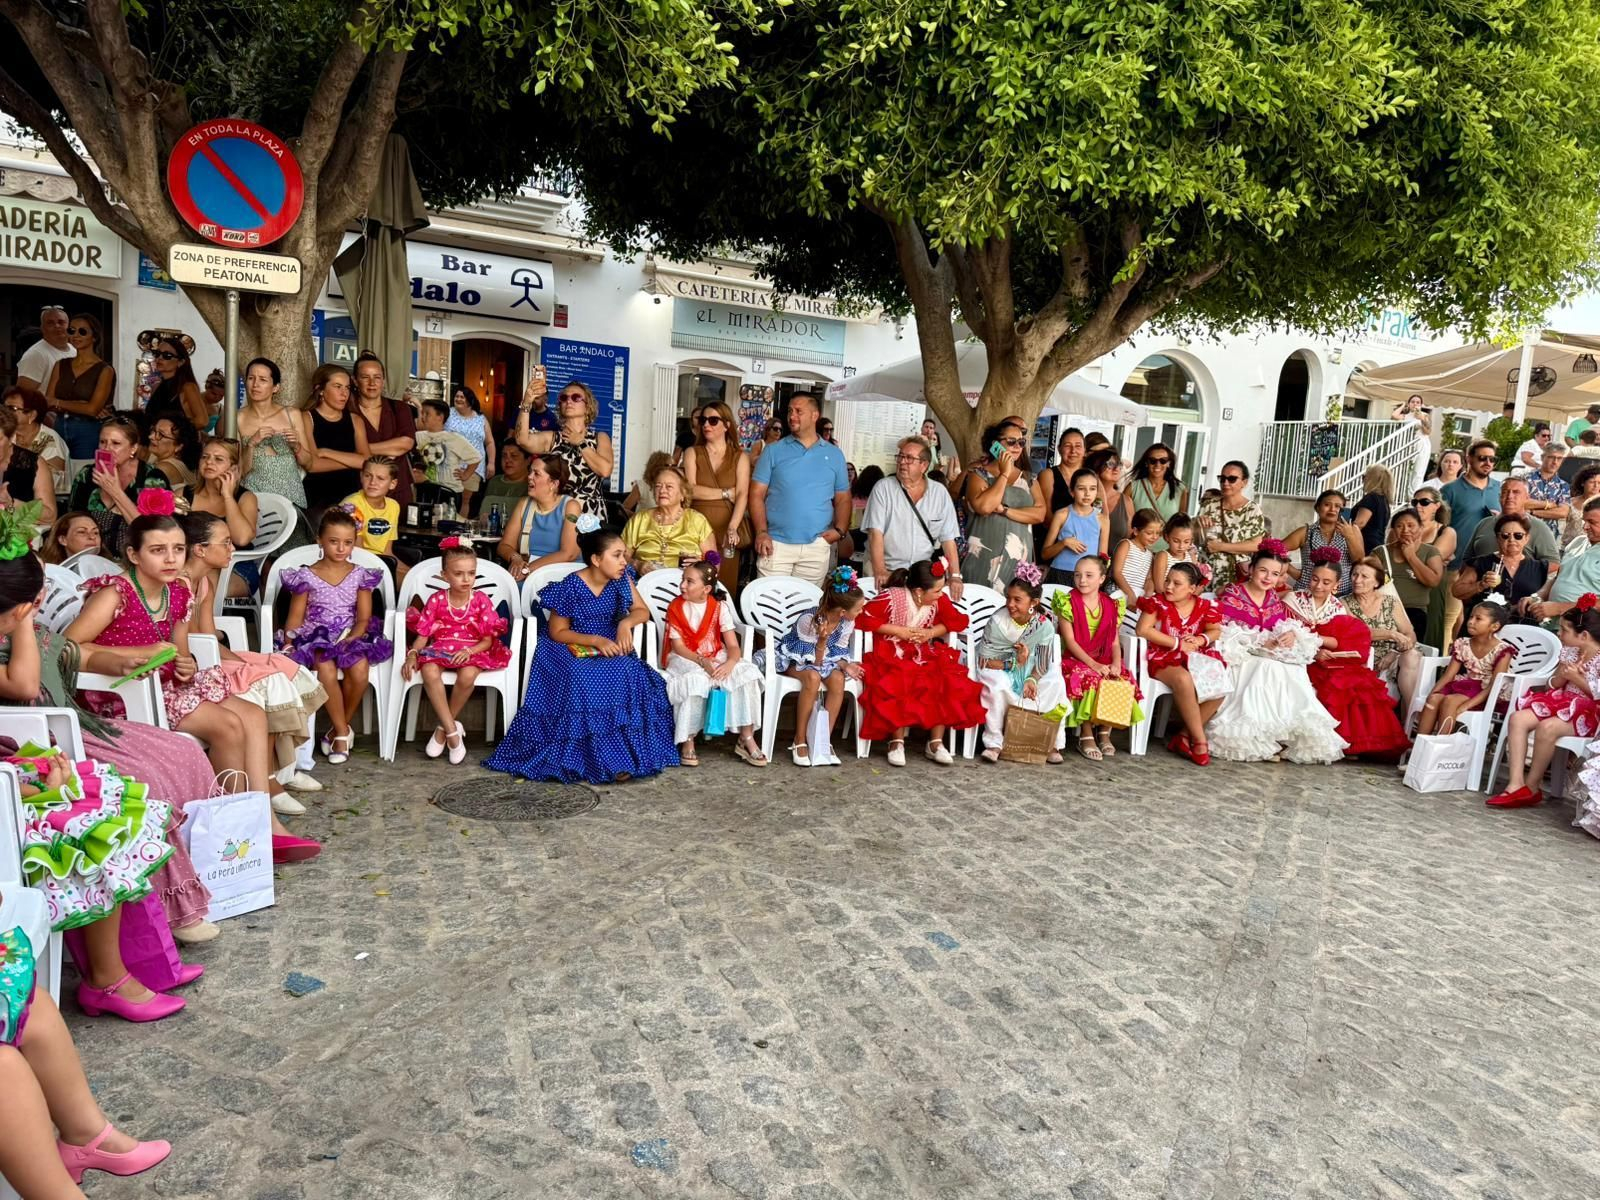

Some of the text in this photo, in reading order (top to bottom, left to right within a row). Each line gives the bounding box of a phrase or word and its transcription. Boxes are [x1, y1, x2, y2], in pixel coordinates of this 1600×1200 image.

[188, 124, 284, 158] EN TODA LA PLAZA
[0, 234, 102, 269] IRADOR
[173, 251, 298, 273] ZONA DE PREFERENCIA
[203, 267, 270, 284] PEATONAL
[441, 254, 492, 276] Bar
[677, 280, 767, 307] CAFETERÍA
[559, 343, 579, 354] BAR
